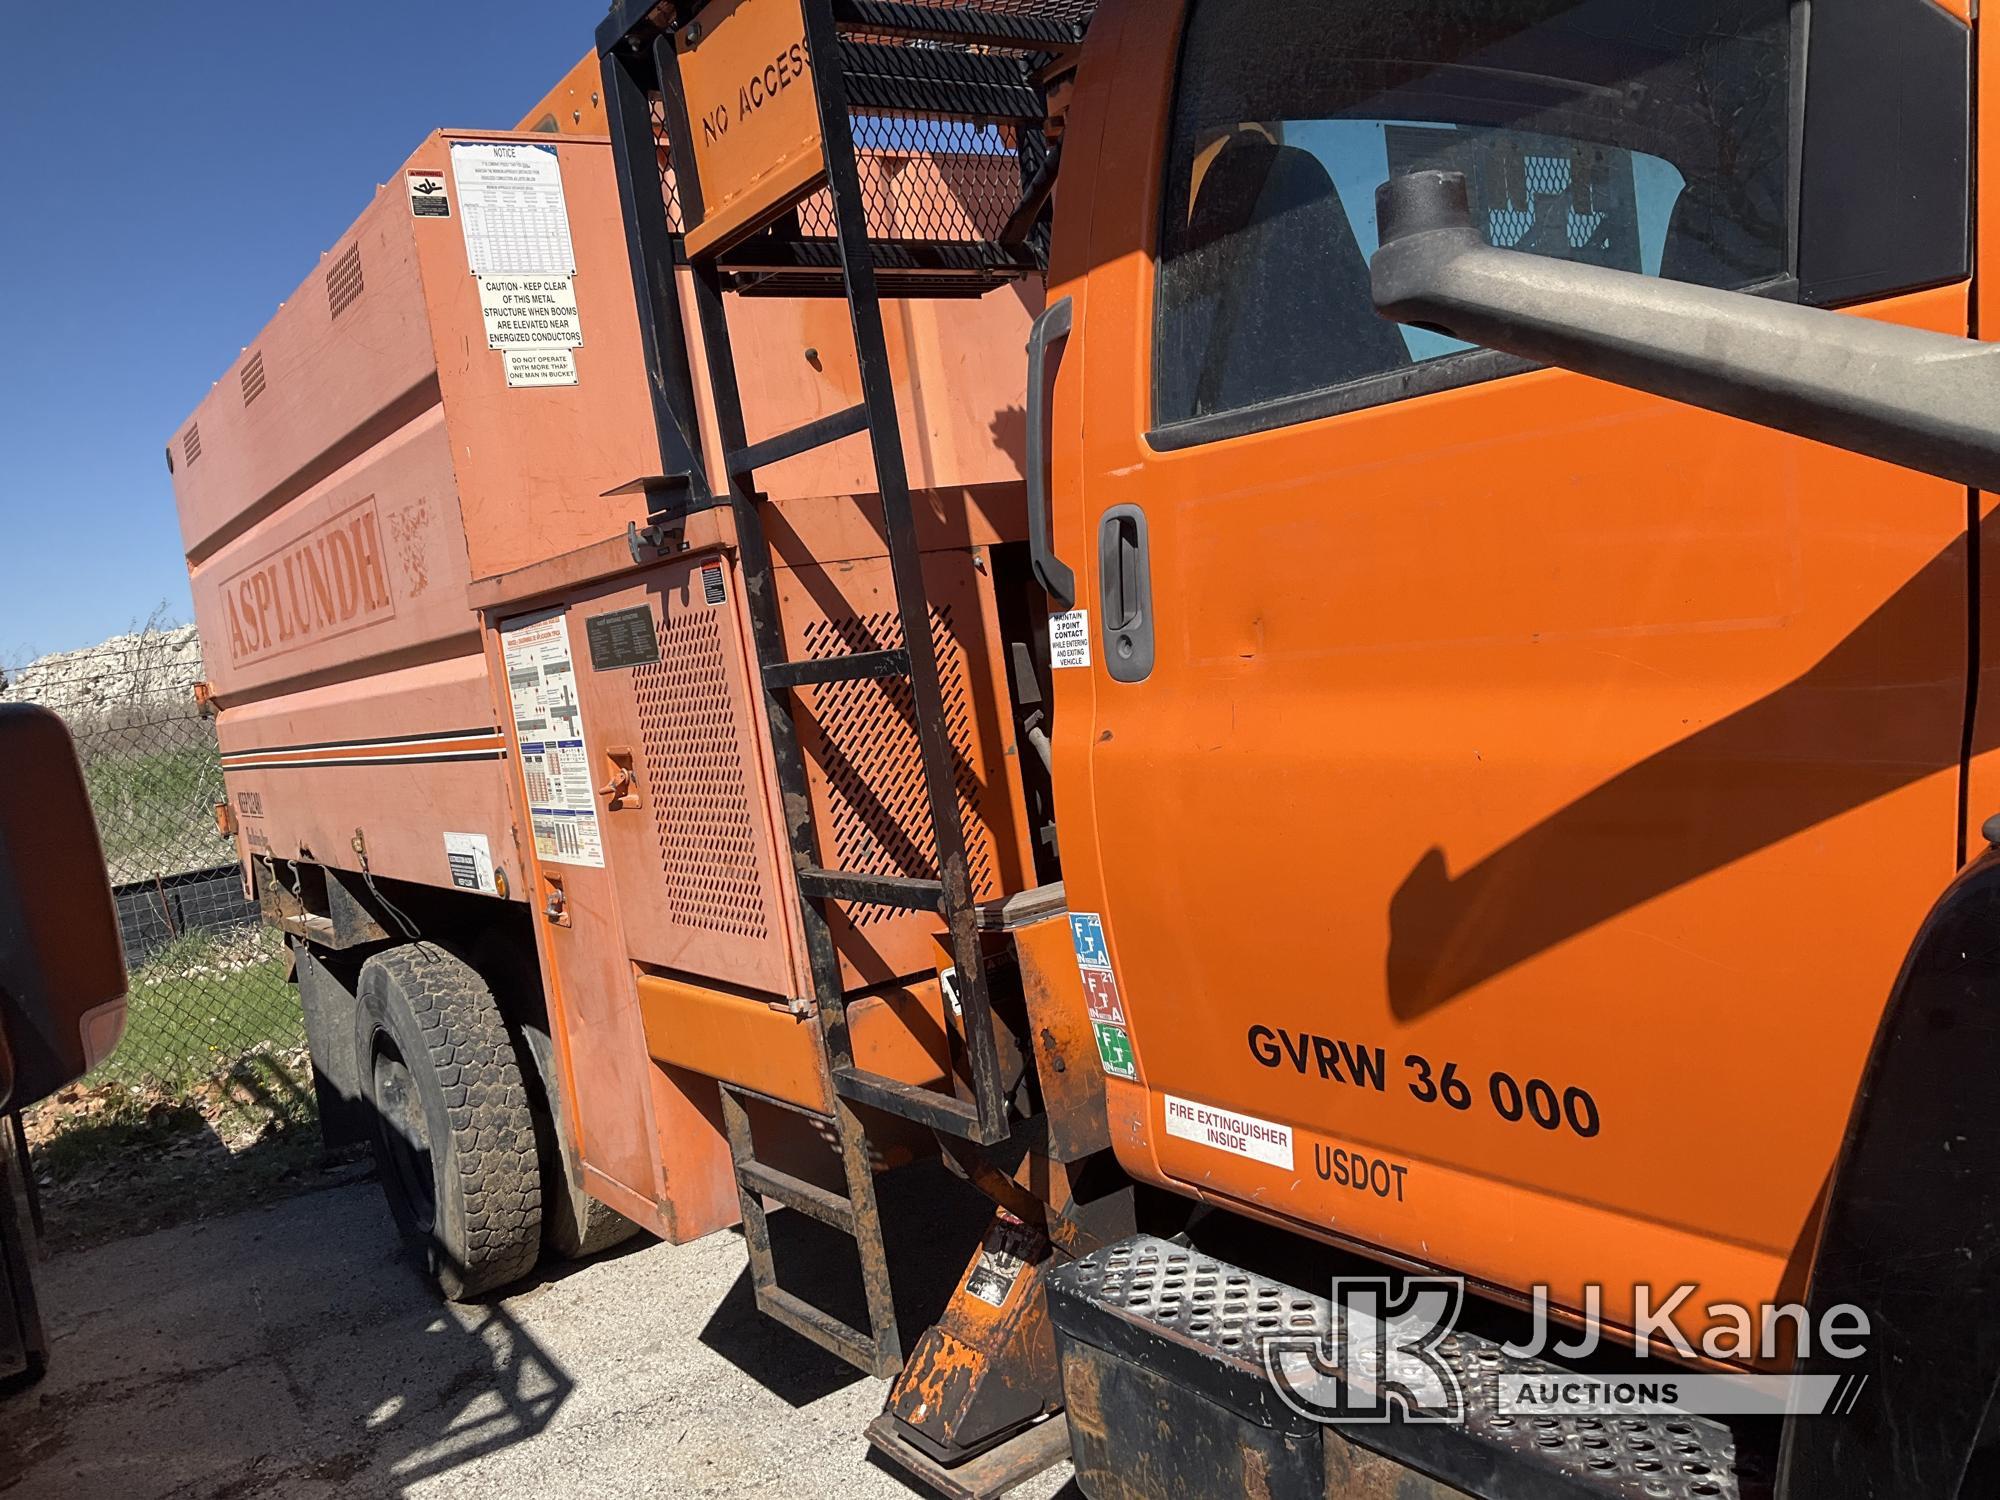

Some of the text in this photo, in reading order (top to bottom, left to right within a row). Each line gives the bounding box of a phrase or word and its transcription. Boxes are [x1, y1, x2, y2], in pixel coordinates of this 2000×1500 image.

[702, 104, 729, 147] NO
[493, 147, 516, 158] NOTICE
[486, 282, 518, 291] CAUTION
[523, 282, 542, 291] KEEP
[543, 282, 567, 291] CLEAR
[502, 294, 556, 304] OF THIS METAL
[484, 307, 577, 317] STRUCTURE WHEN BOOMS
[497, 319, 569, 329] ARE ELEVATED NEAR
[489, 332, 580, 342] ENERGIZED CONDUCTORS
[227, 511, 389, 660] ASPLUNDH
[1054, 613, 1082, 621] MAINTAIN
[1056, 621, 1080, 631] 3 POINT
[1055, 630, 1083, 639] CONTACT
[1052, 639, 1087, 649] WHILE ENTERING
[1057, 648, 1084, 658] AND EXITING
[1060, 658, 1082, 666] VEHICLE
[1101, 971, 1113, 983] 21
[1247, 1024, 1600, 1138] GVRW 36 000
[1169, 1102, 1287, 1147] FIRE EXTINGUISHER
[1207, 1128, 1247, 1152] INSIDE
[1314, 1142, 1408, 1202] USDOT
